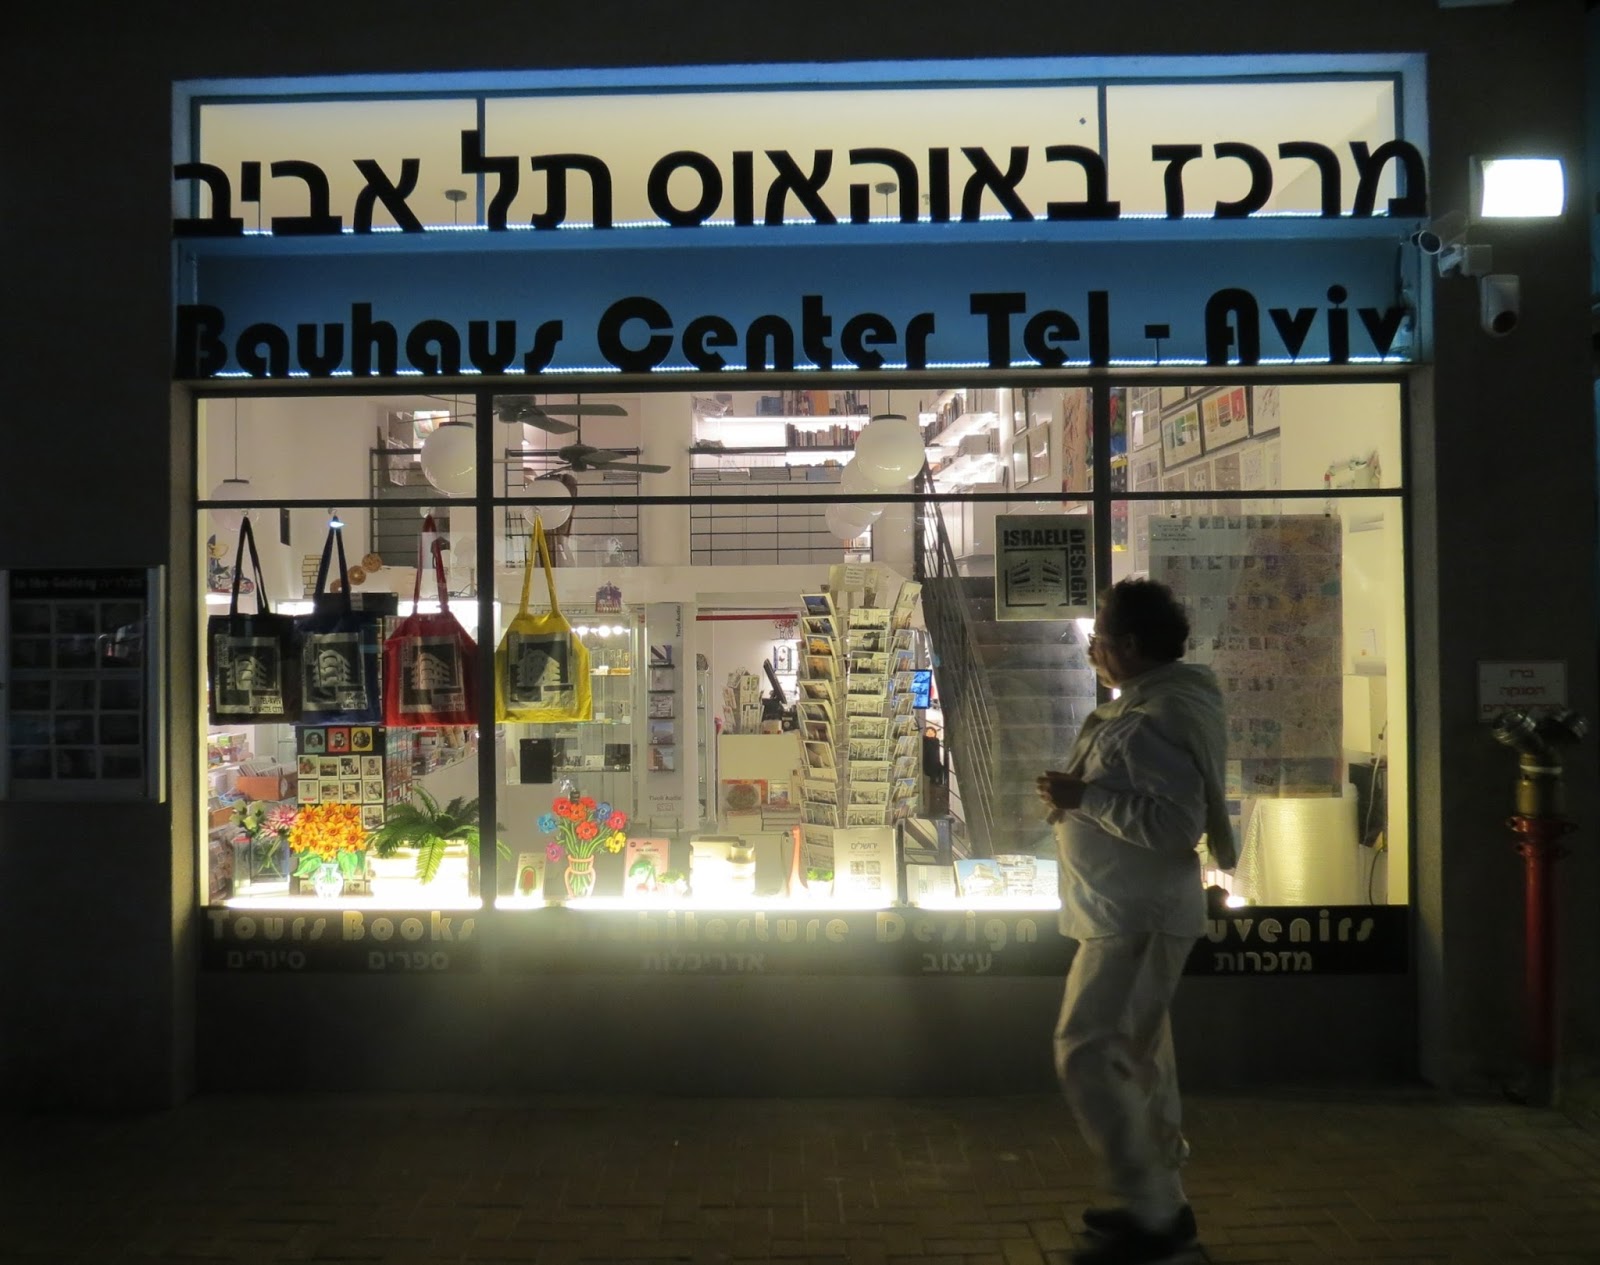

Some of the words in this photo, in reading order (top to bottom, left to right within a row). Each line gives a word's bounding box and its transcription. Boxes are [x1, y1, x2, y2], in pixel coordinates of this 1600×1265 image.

[174, 158, 424, 235] אביב
[461, 129, 613, 231] תל
[647, 145, 1120, 229] באוהאוס
[1152, 139, 1428, 220] מרכז
[176, 302, 563, 378] Bauhaus
[597, 296, 935, 374] Center
[970, 291, 1109, 369] Tel
[1205, 284, 1410, 366] Aviv
[1003, 529, 1067, 546] ISRAELI
[1070, 529, 1087, 606] DESIGN
[207, 910, 326, 940] Tours
[342, 910, 474, 941] Books
[876, 910, 1037, 951] Design
[1206, 909, 1374, 943] uvenirs
[227, 951, 306, 970] סיורים
[368, 951, 449, 970] ספרים
[922, 953, 992, 974] עיצוב
[1214, 951, 1313, 972] מזכרות
